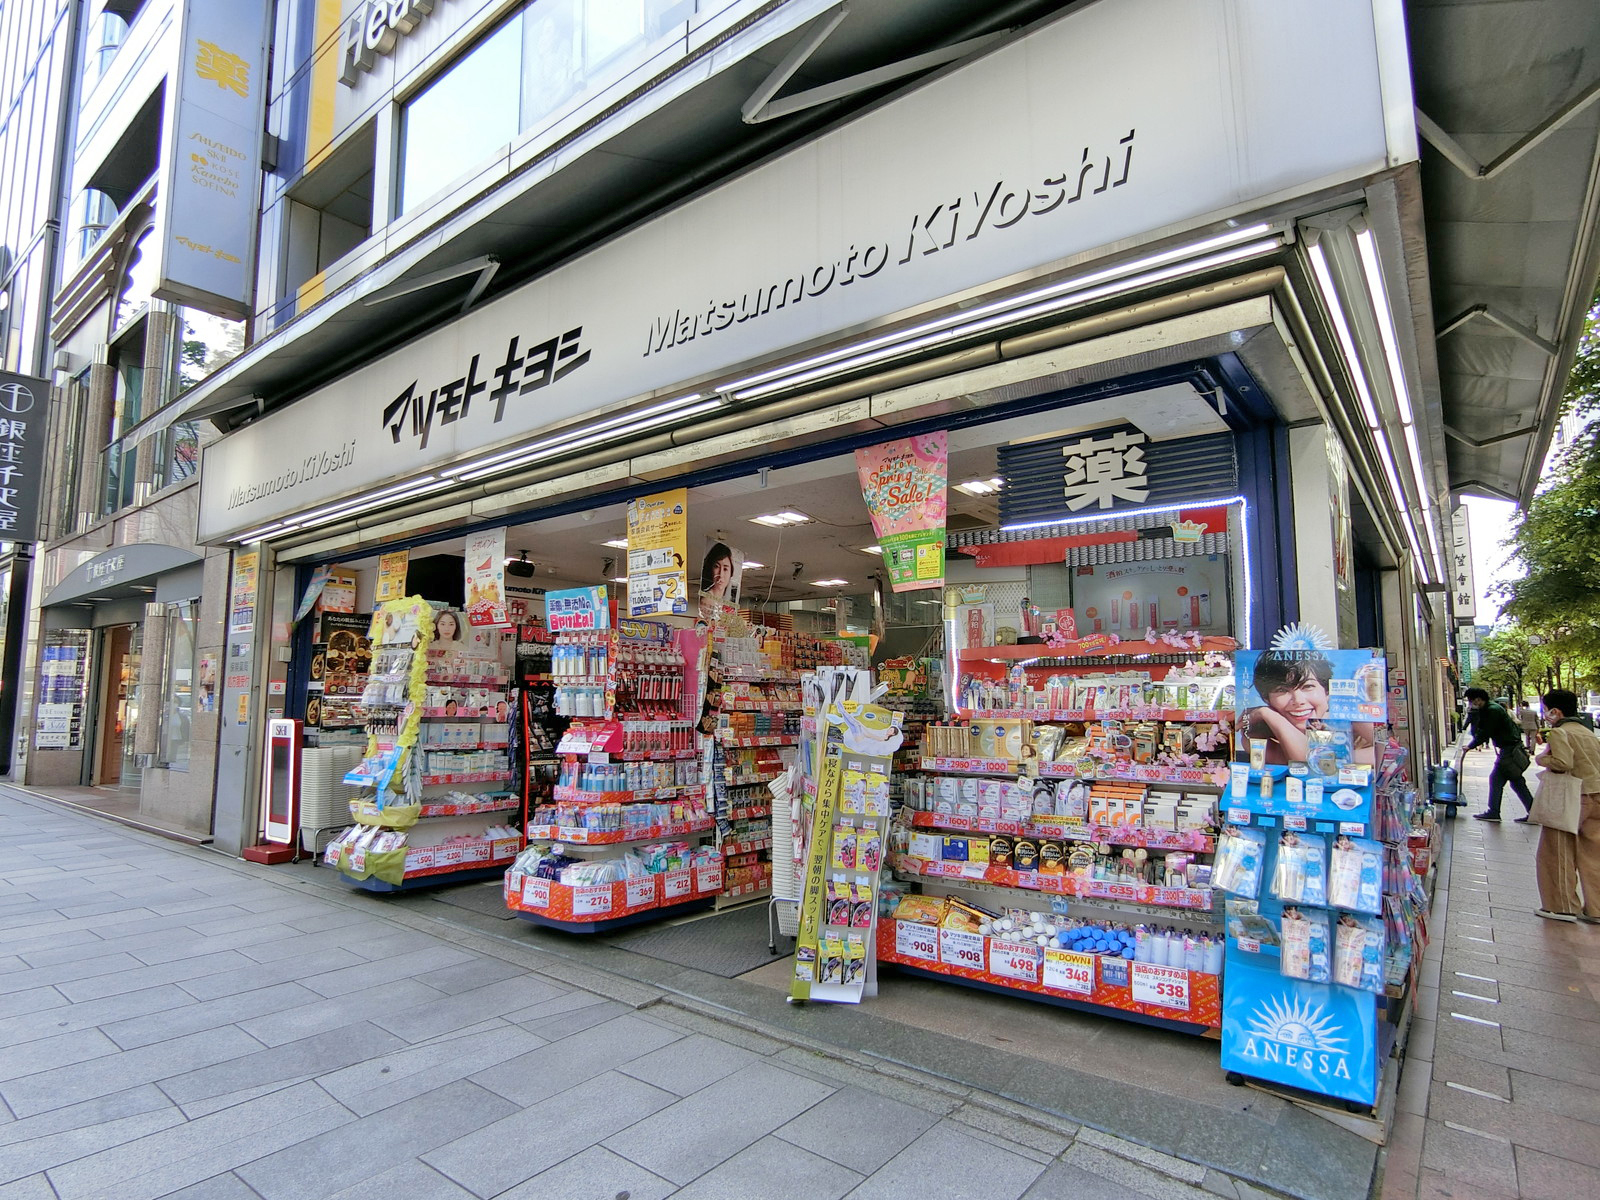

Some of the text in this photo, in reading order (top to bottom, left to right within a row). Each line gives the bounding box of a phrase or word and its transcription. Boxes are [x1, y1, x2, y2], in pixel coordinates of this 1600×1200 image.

[195, 38, 251, 98] 薬
[188, 132, 247, 161] SHISEIDO
[190, 165, 239, 189] Kanebo
[191, 175, 237, 199] SOFINA
[174, 235, 242, 264] マツモトキヨシ
[643, 129, 1135, 358] Matsumoto KiYoshi
[382, 326, 591, 450] マツモトキヨシ
[880, 459, 917, 473] ENJOY!
[1063, 432, 1149, 512] 薬
[0, 418, 27, 531] 銀座千疋屋
[227, 438, 357, 511] Matsumoto KiYoshi
[869, 472, 913, 494] Spring
[887, 482, 932, 507] Sale!
[1454, 536, 1471, 605] 三笠會館
[621, 621, 650, 639] UV
[1273, 651, 1331, 661] ANESSA
[1331, 681, 1356, 689] 世界初
[950, 760, 970, 769] 2980
[986, 762, 1006, 770] 1000
[1051, 764, 1074, 772] 5000
[1265, 808, 1318, 817] ビューティーサンケア
[950, 817, 968, 826] 1600
[995, 822, 1016, 831] 1600
[1041, 827, 1062, 836] 450
[806, 758, 839, 940] 寝ながら集中ケアで、翌朝の脚スッキリ。
[943, 864, 962, 873] 1500
[676, 879, 689, 889] 212
[707, 873, 720, 883] 380
[1037, 878, 1059, 887] 538
[534, 889, 547, 899] 900
[639, 887, 653, 897] 369
[1109, 885, 1134, 896] 635
[591, 896, 609, 906] 276
[914, 941, 934, 953] 908
[959, 950, 981, 962] 908
[1059, 953, 1087, 965] DOWN
[1010, 959, 1033, 971] 498
[1065, 968, 1089, 983] 348
[1135, 965, 1188, 980] 当店のおすすめ品
[1156, 983, 1184, 998] 538
[1242, 1038, 1351, 1079] ANESSA
